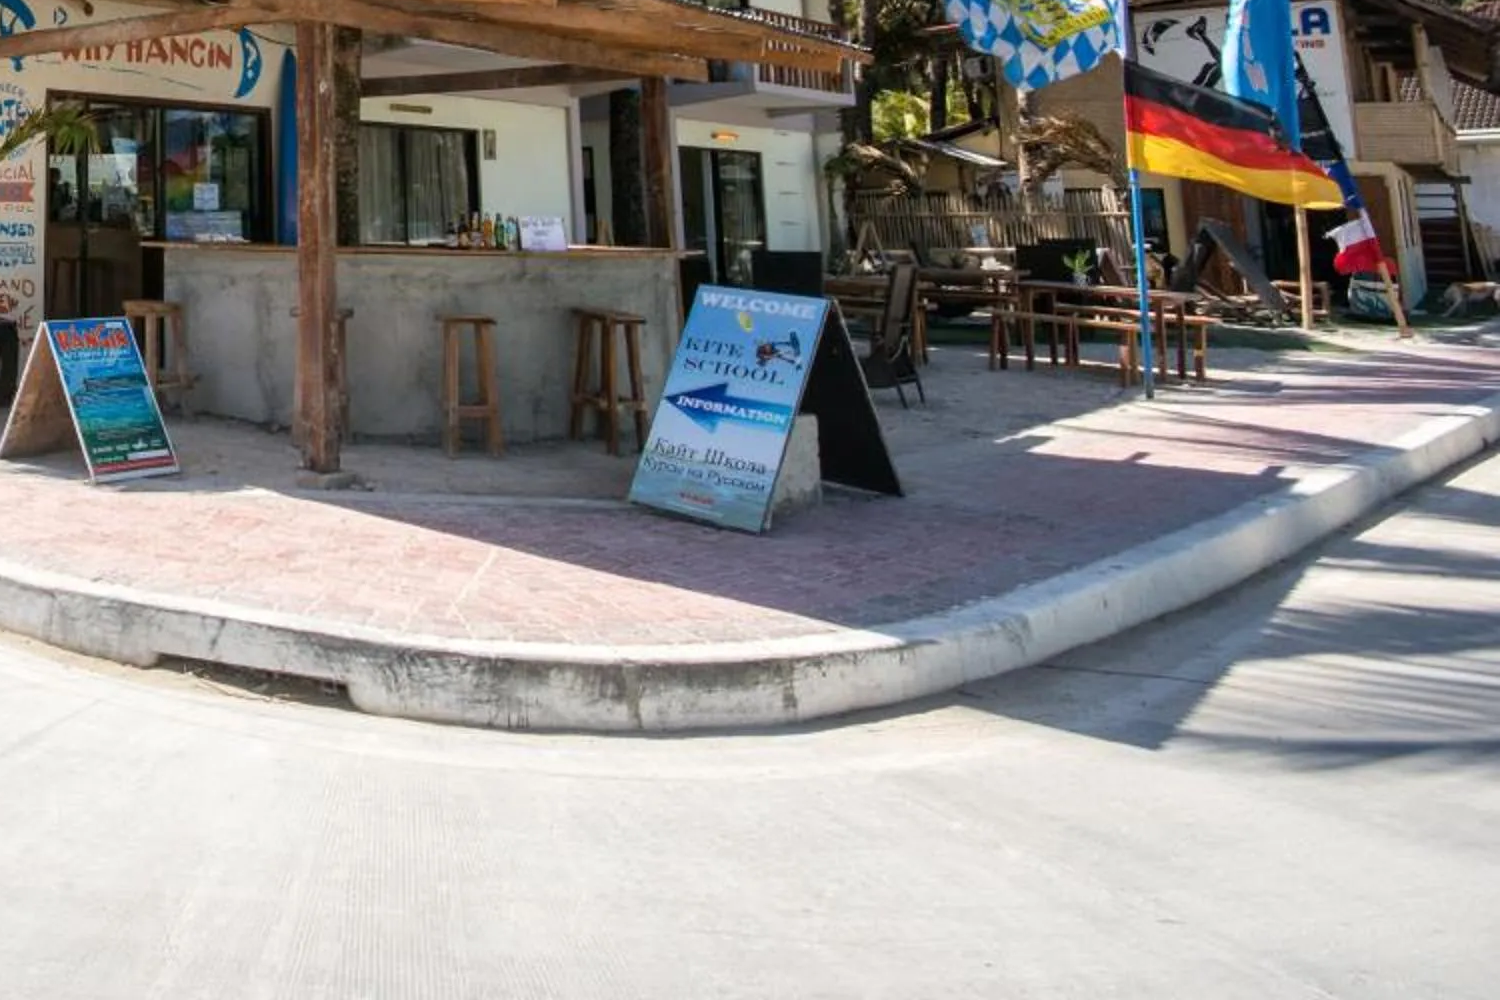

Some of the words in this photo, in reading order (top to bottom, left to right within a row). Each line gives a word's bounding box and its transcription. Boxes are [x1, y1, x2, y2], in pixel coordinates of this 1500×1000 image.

[702, 292, 817, 319] WELCOME
[686, 337, 745, 359] KITE
[683, 357, 785, 385] SCHOOL
[676, 396, 787, 425] INFORMATION
